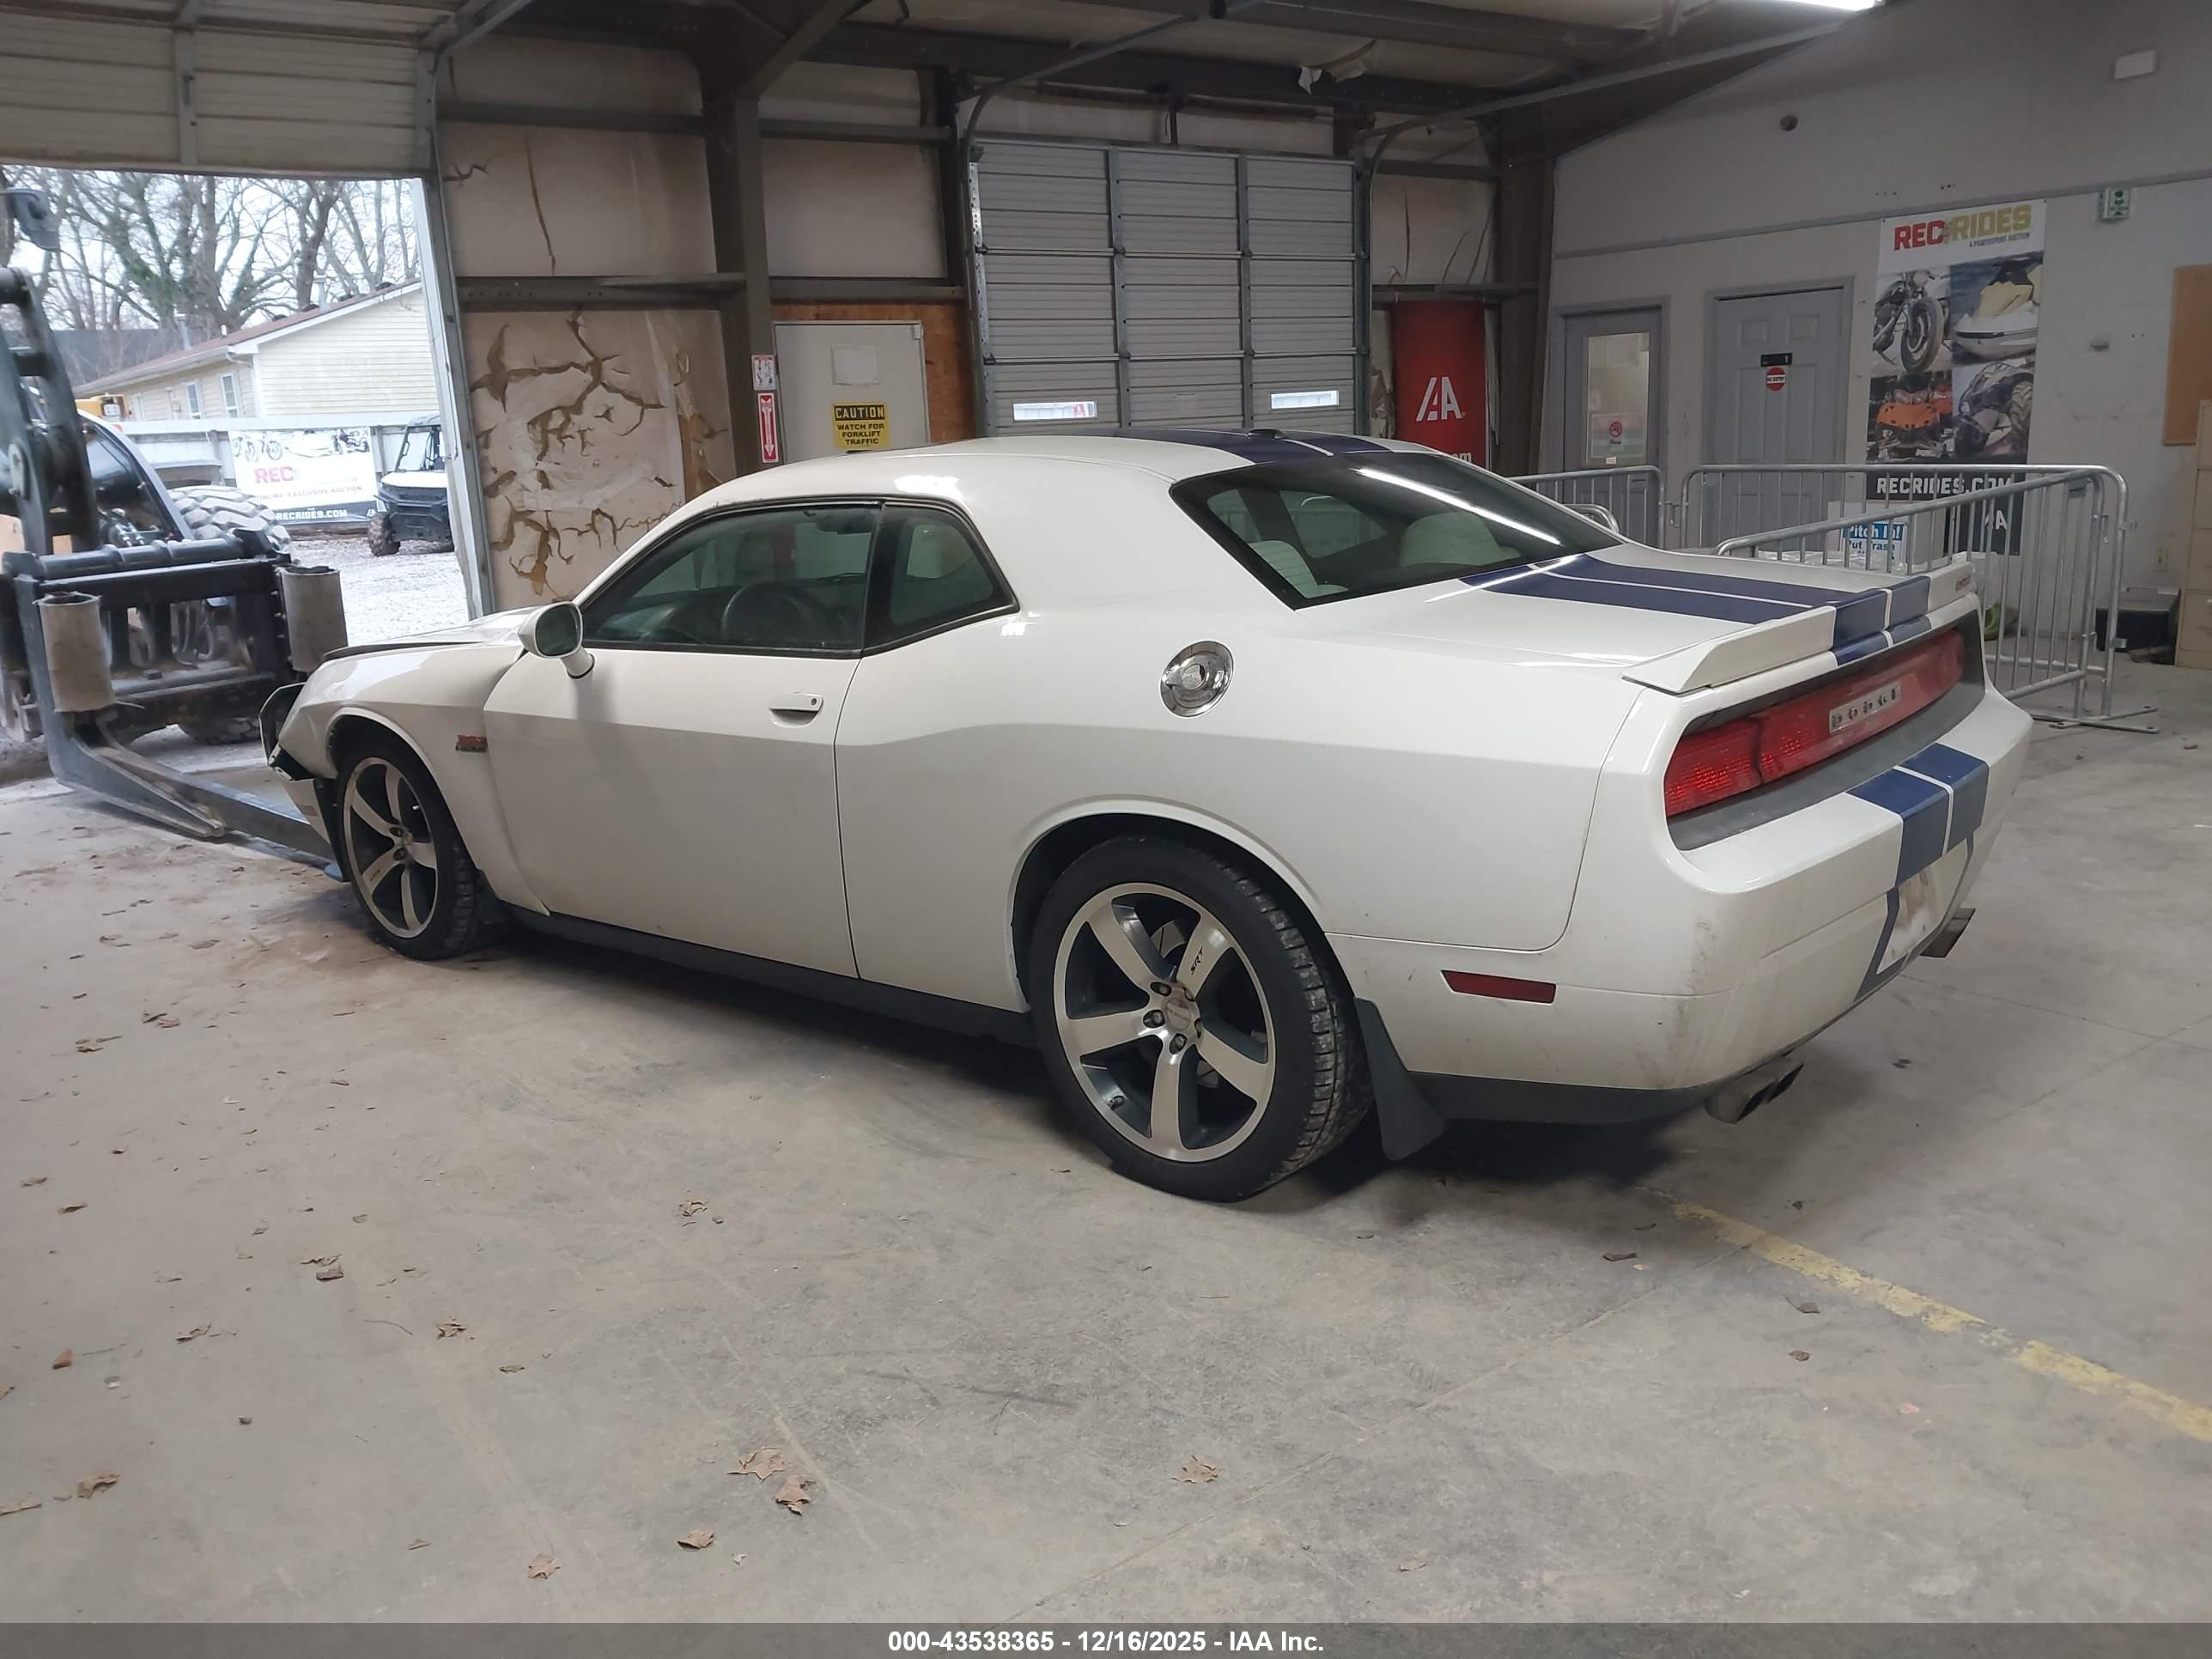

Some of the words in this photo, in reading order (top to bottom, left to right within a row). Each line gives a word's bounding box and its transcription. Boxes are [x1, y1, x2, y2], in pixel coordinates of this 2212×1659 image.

[835, 406, 884, 418] CAUTION
[253, 465, 294, 484] REC
[331, 485, 362, 494] AUCTION
[276, 509, 348, 521] RECRIDES.COM
[1849, 540, 1863, 550] ut
[1870, 542, 1895, 550] ras
